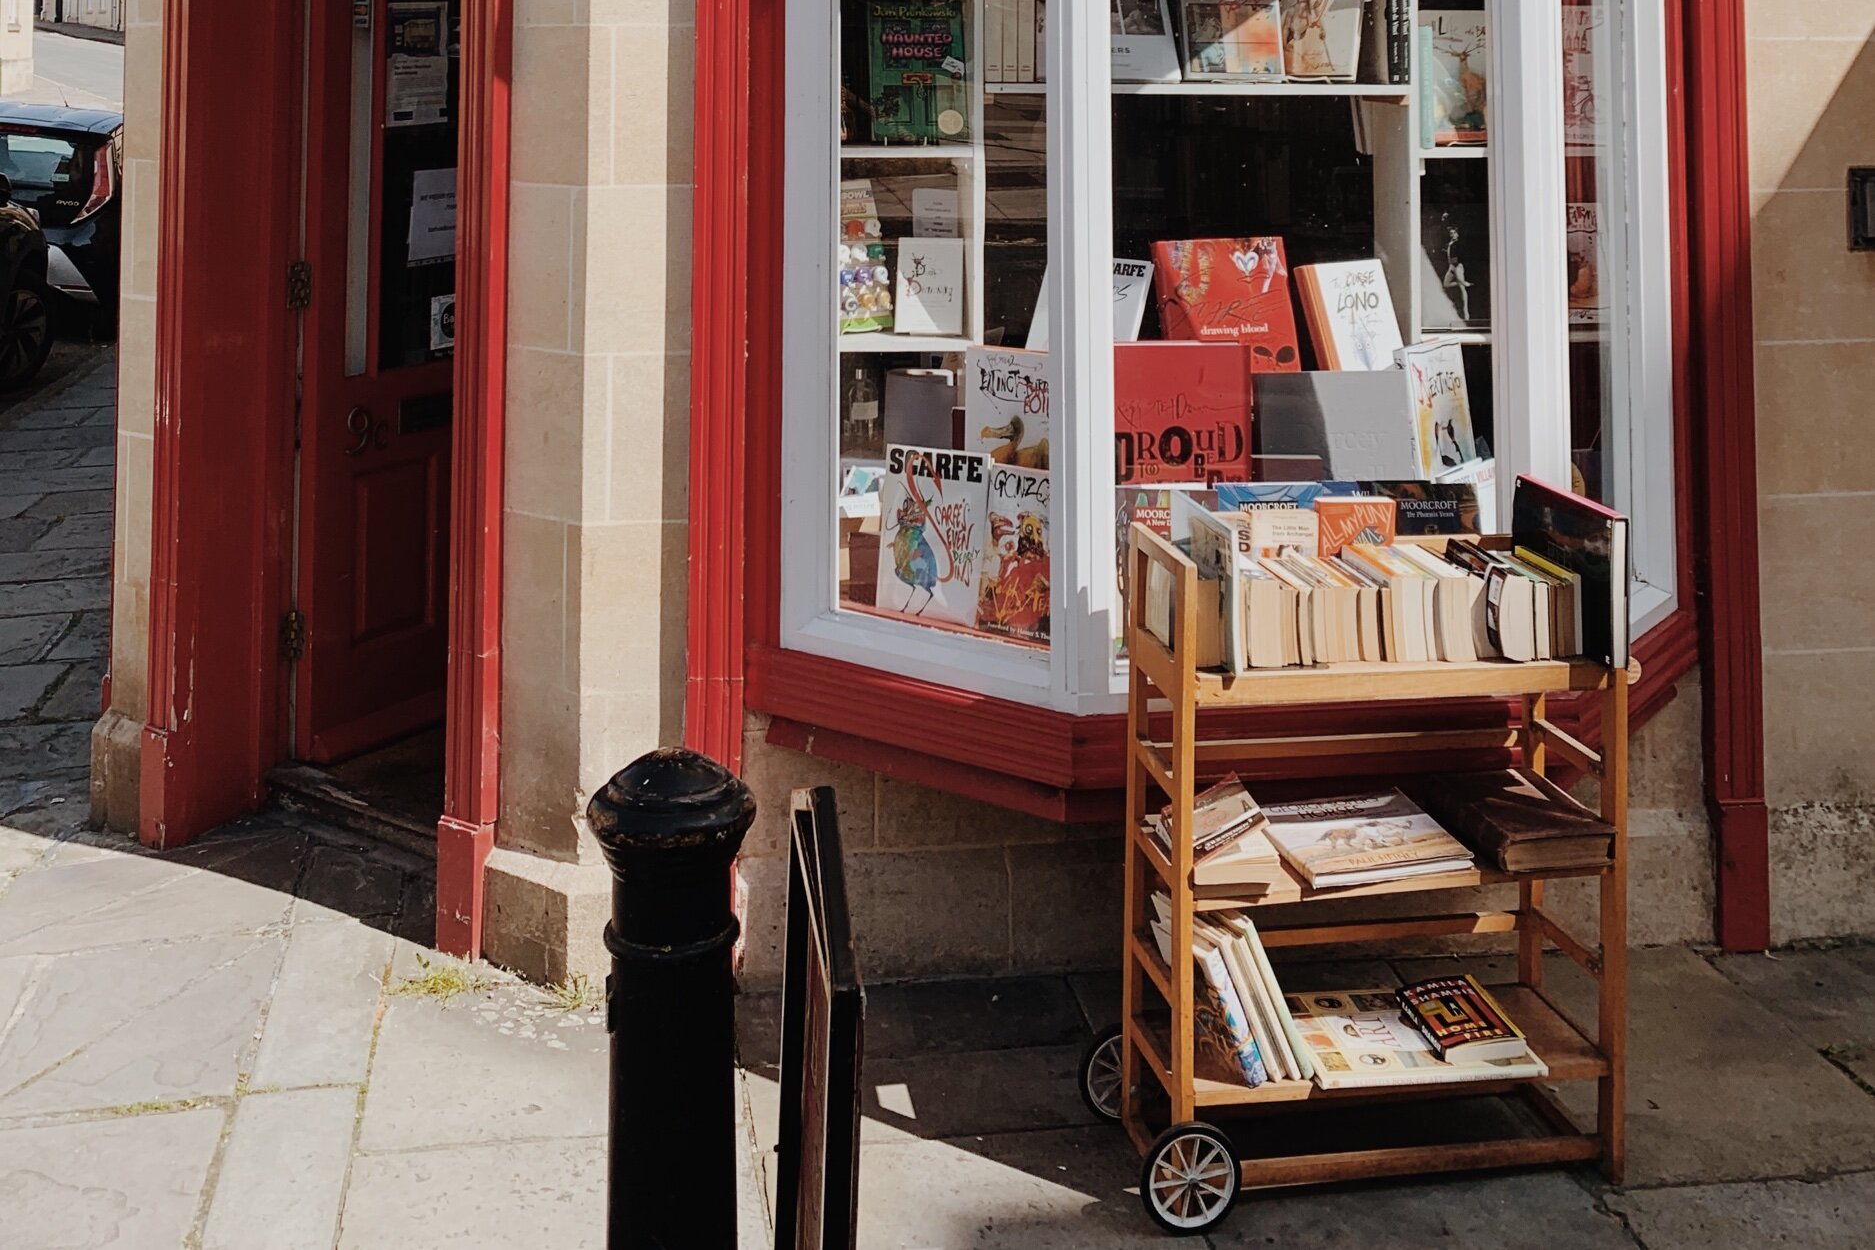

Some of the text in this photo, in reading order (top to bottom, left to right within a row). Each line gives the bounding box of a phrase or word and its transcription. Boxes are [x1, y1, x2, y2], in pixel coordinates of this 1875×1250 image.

[881, 33, 953, 45] HAUNTED
[891, 47, 942, 58] HOUSE
[1113, 262, 1147, 278] ARFE
[1337, 291, 1380, 313] LONO
[1200, 323, 1269, 336] drawing blood
[889, 448, 983, 483] SCARFE
[1400, 500, 1458, 510] MOORCROFT
[1322, 504, 1393, 556] ALL MY PUNY
[1297, 805, 1365, 819] HORSES
[1403, 979, 1467, 997] KAMILA
[1410, 988, 1477, 1006] SHAMSIE
[1436, 1020, 1488, 1037] HOME
